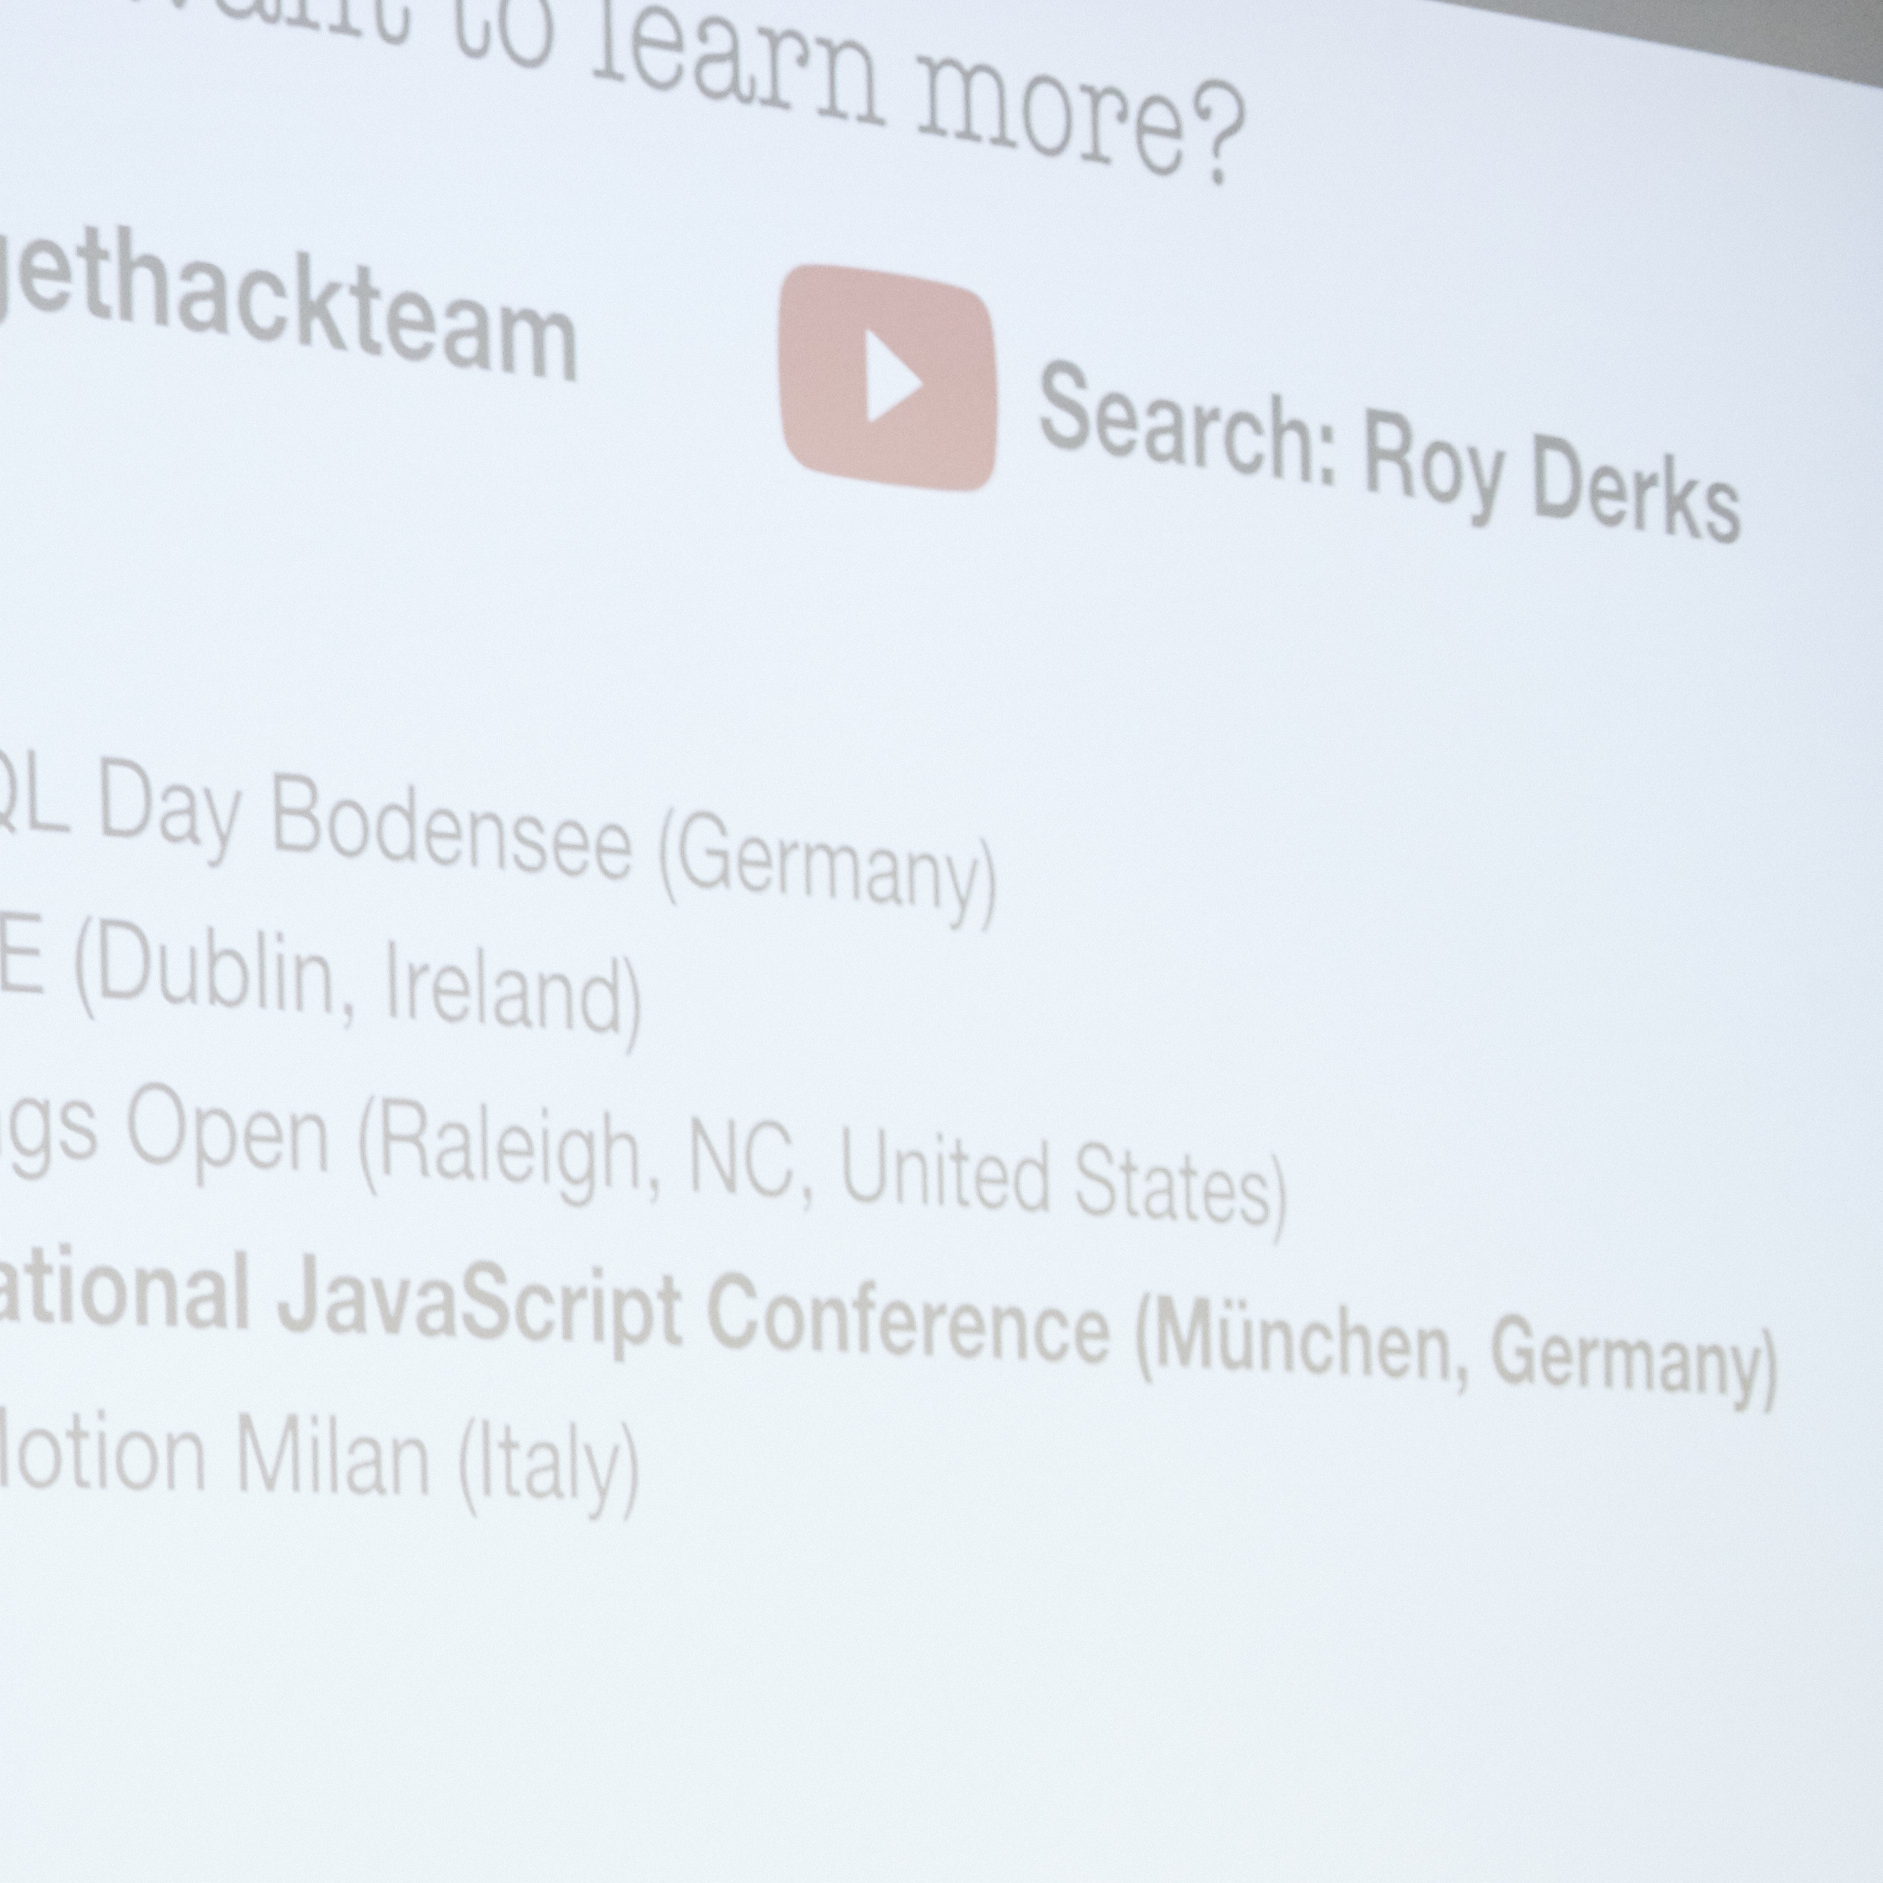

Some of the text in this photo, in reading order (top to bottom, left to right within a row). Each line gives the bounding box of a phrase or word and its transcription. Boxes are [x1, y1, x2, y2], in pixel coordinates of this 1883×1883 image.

[590, 0, 888, 129] learn
[914, 53, 1248, 188] more?
[1038, 357, 1743, 546] Search: Roy Derks
[99, 754, 243, 870] Day
[272, 770, 633, 882] Bodensee
[658, 807, 998, 932] (Germany)
[73, 915, 355, 1029] (Dublin,
[387, 939, 642, 1055] Ireland)
[126, 1080, 329, 1189] Open
[357, 1095, 660, 1209] (Raleigh,
[690, 1115, 813, 1209] NC,
[841, 1125, 1051, 1214] United
[1075, 1140, 1287, 1244] States)
[276, 1251, 684, 1364] JavaScript
[706, 1270, 1111, 1366] Conference
[1134, 1291, 1469, 1395] (München,
[1490, 1311, 1778, 1415] Germany)
[237, 1411, 430, 1497] Milan
[458, 1417, 640, 1522] (Italy)
